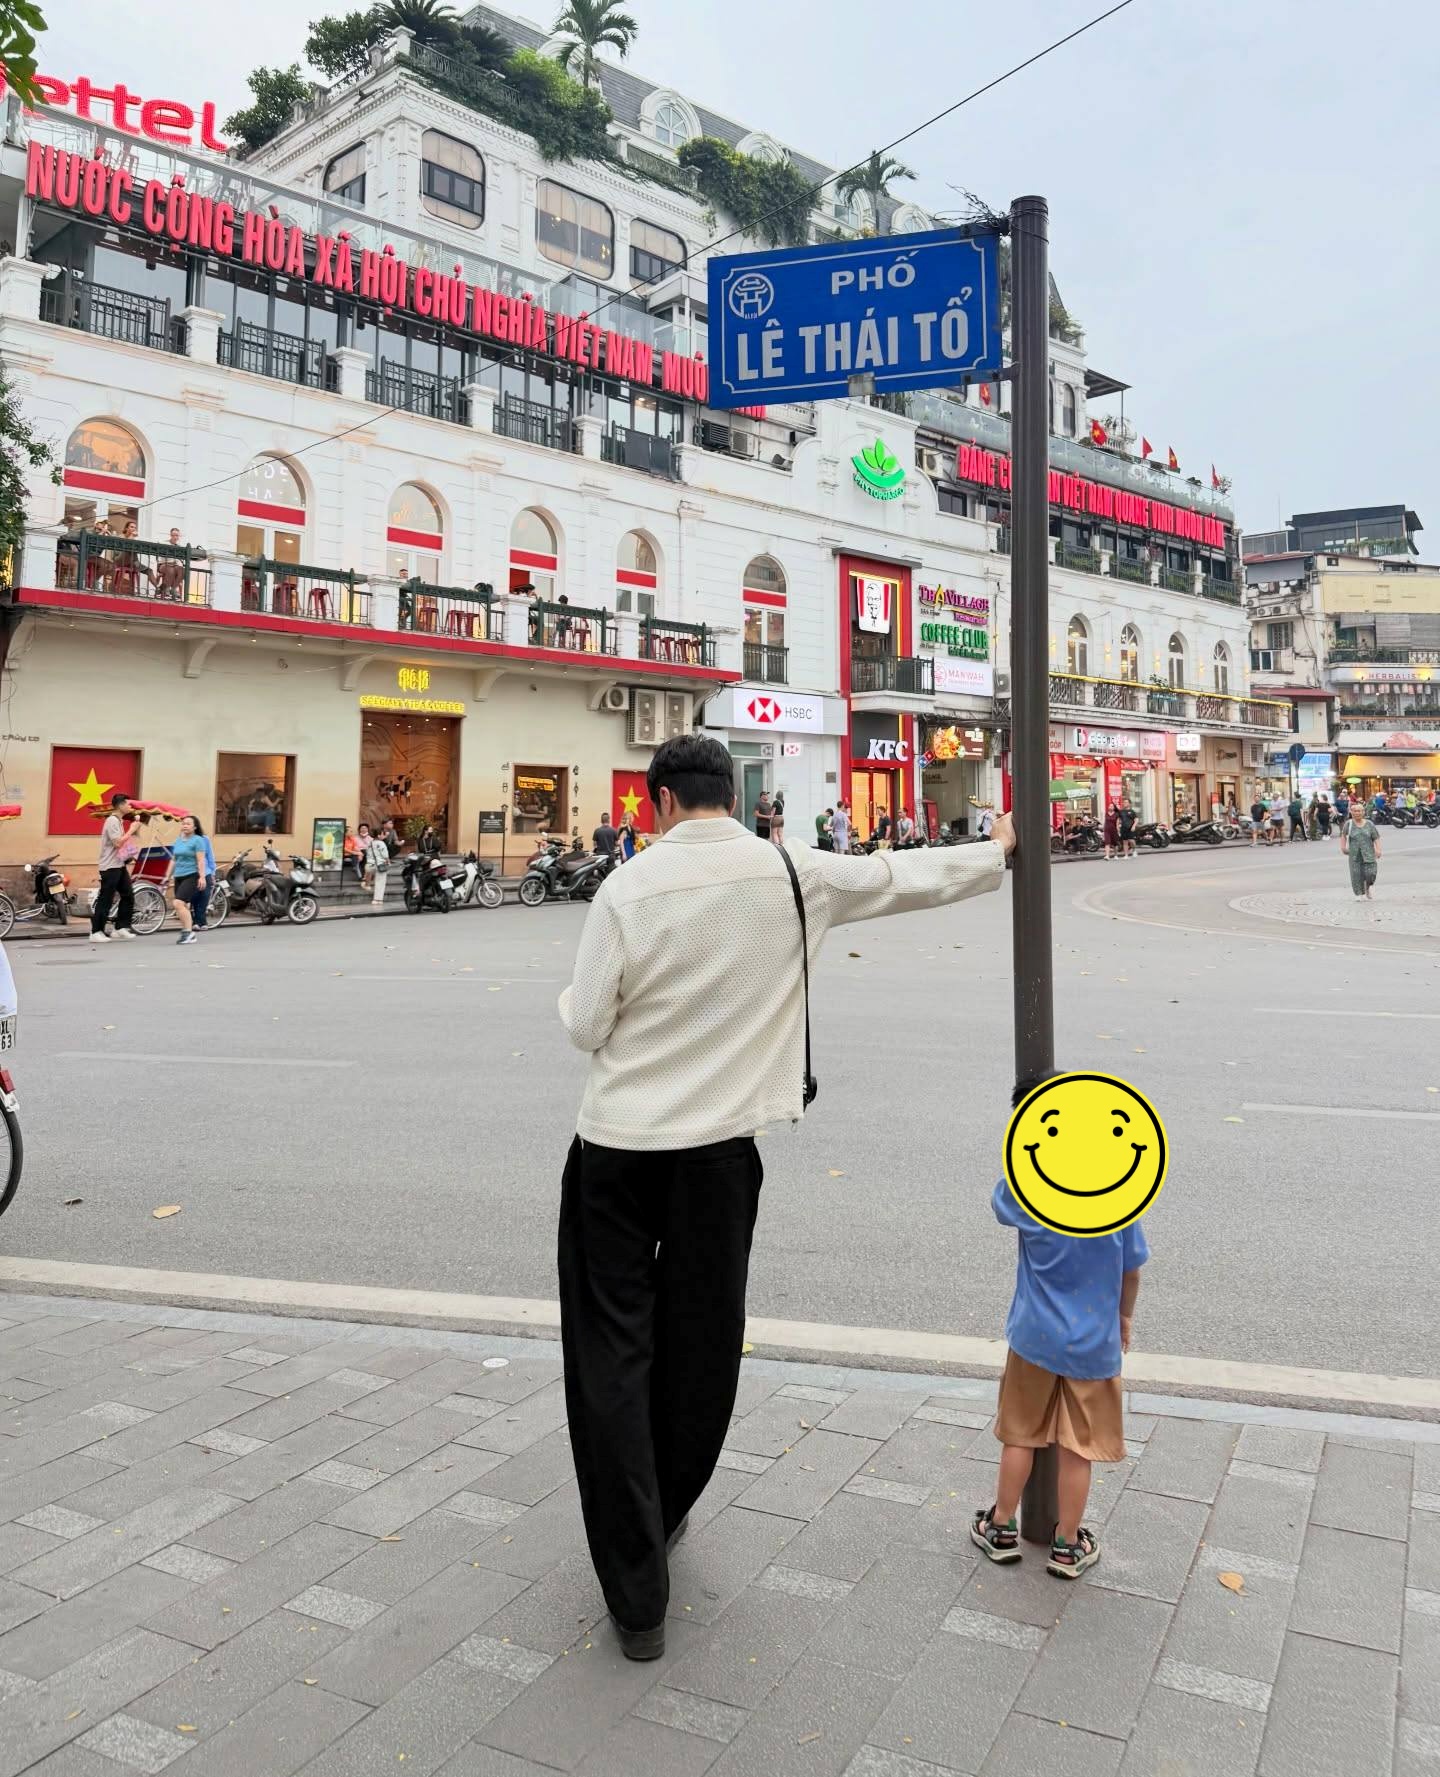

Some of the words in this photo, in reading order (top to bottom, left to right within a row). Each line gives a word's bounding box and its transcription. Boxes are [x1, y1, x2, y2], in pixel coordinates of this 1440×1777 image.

[26, 139, 133, 226] NƯỚC
[143, 174, 233, 256] CỘNG
[243, 204, 305, 279] HÒA
[313, 230, 354, 294] XÃ
[360, 244, 406, 316] HỘI
[414, 264, 466, 327] CHỦ
[473, 292, 547, 354] NGHĨA
[555, 311, 604, 375] VIỆT
[605, 331, 653, 386] NAM
[661, 350, 710, 404] MUÔ
[831, 251, 919, 295] PHỐ
[737, 319, 785, 381] LÊ
[799, 307, 898, 374] THÁI
[913, 286, 973, 362] TỔ
[921, 623, 960, 645] COFFEE
[962, 628, 989, 650] CLUB
[785, 706, 812, 720] HSBC
[867, 738, 909, 761] KFC
